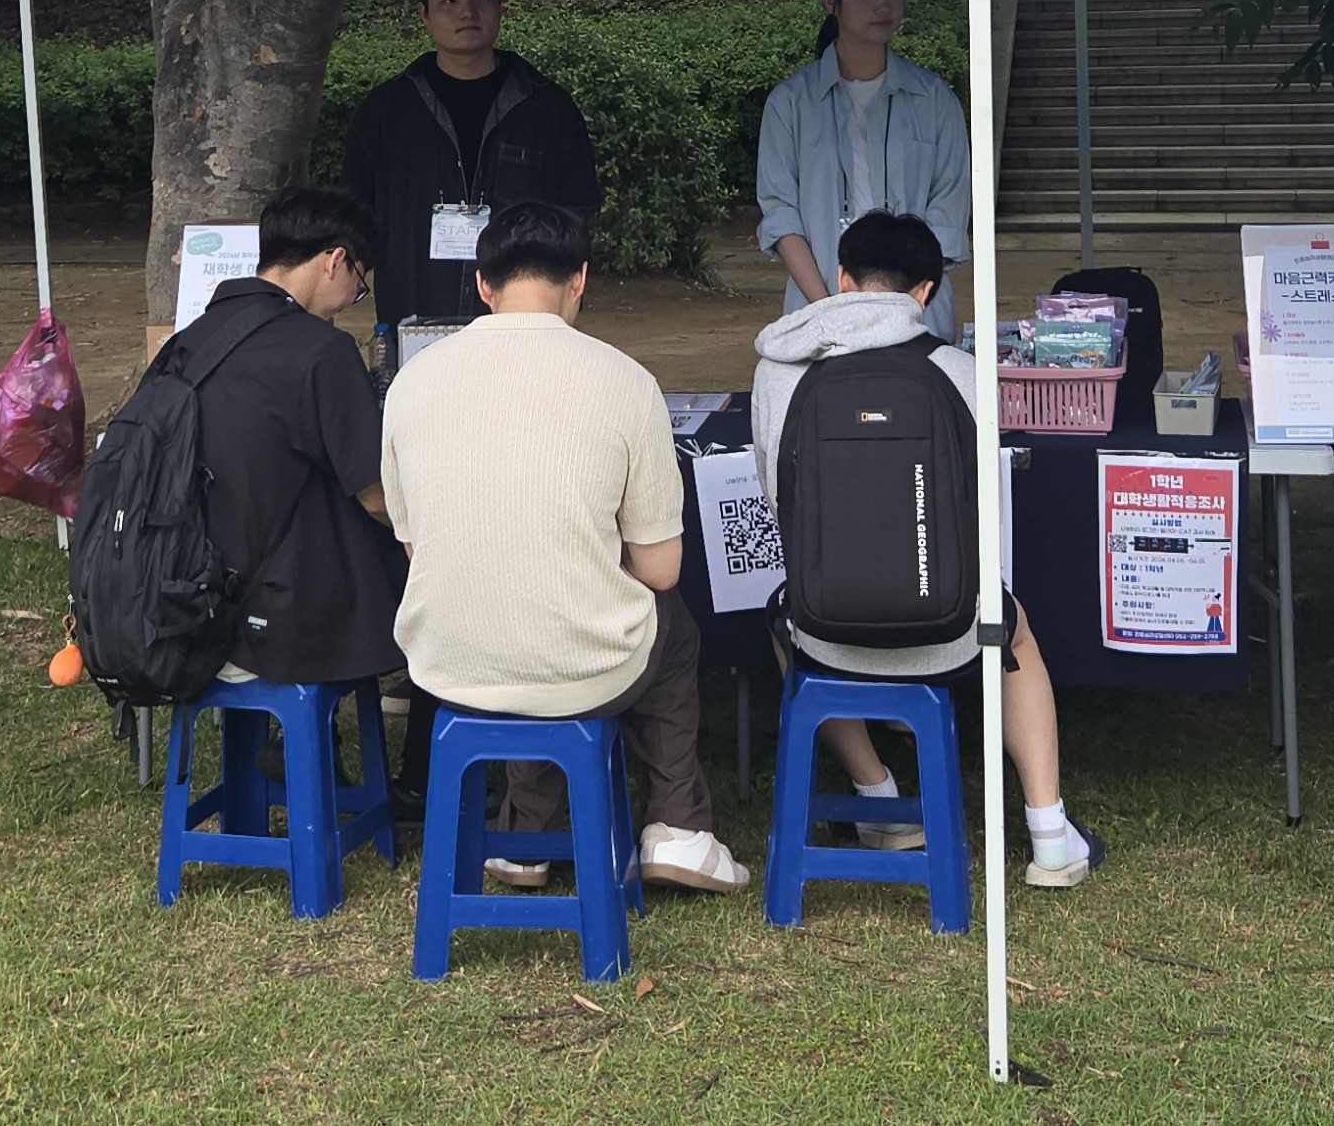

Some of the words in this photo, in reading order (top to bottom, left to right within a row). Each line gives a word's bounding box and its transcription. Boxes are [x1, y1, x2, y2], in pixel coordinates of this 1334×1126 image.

[203, 262, 243, 276] 재학생
[1150, 474, 1184, 489] 1학년
[914, 463, 926, 522] NATIONAL
[1113, 491, 1226, 510] 대학생활적응조사
[916, 523, 929, 597] GEOGRAPHIC
